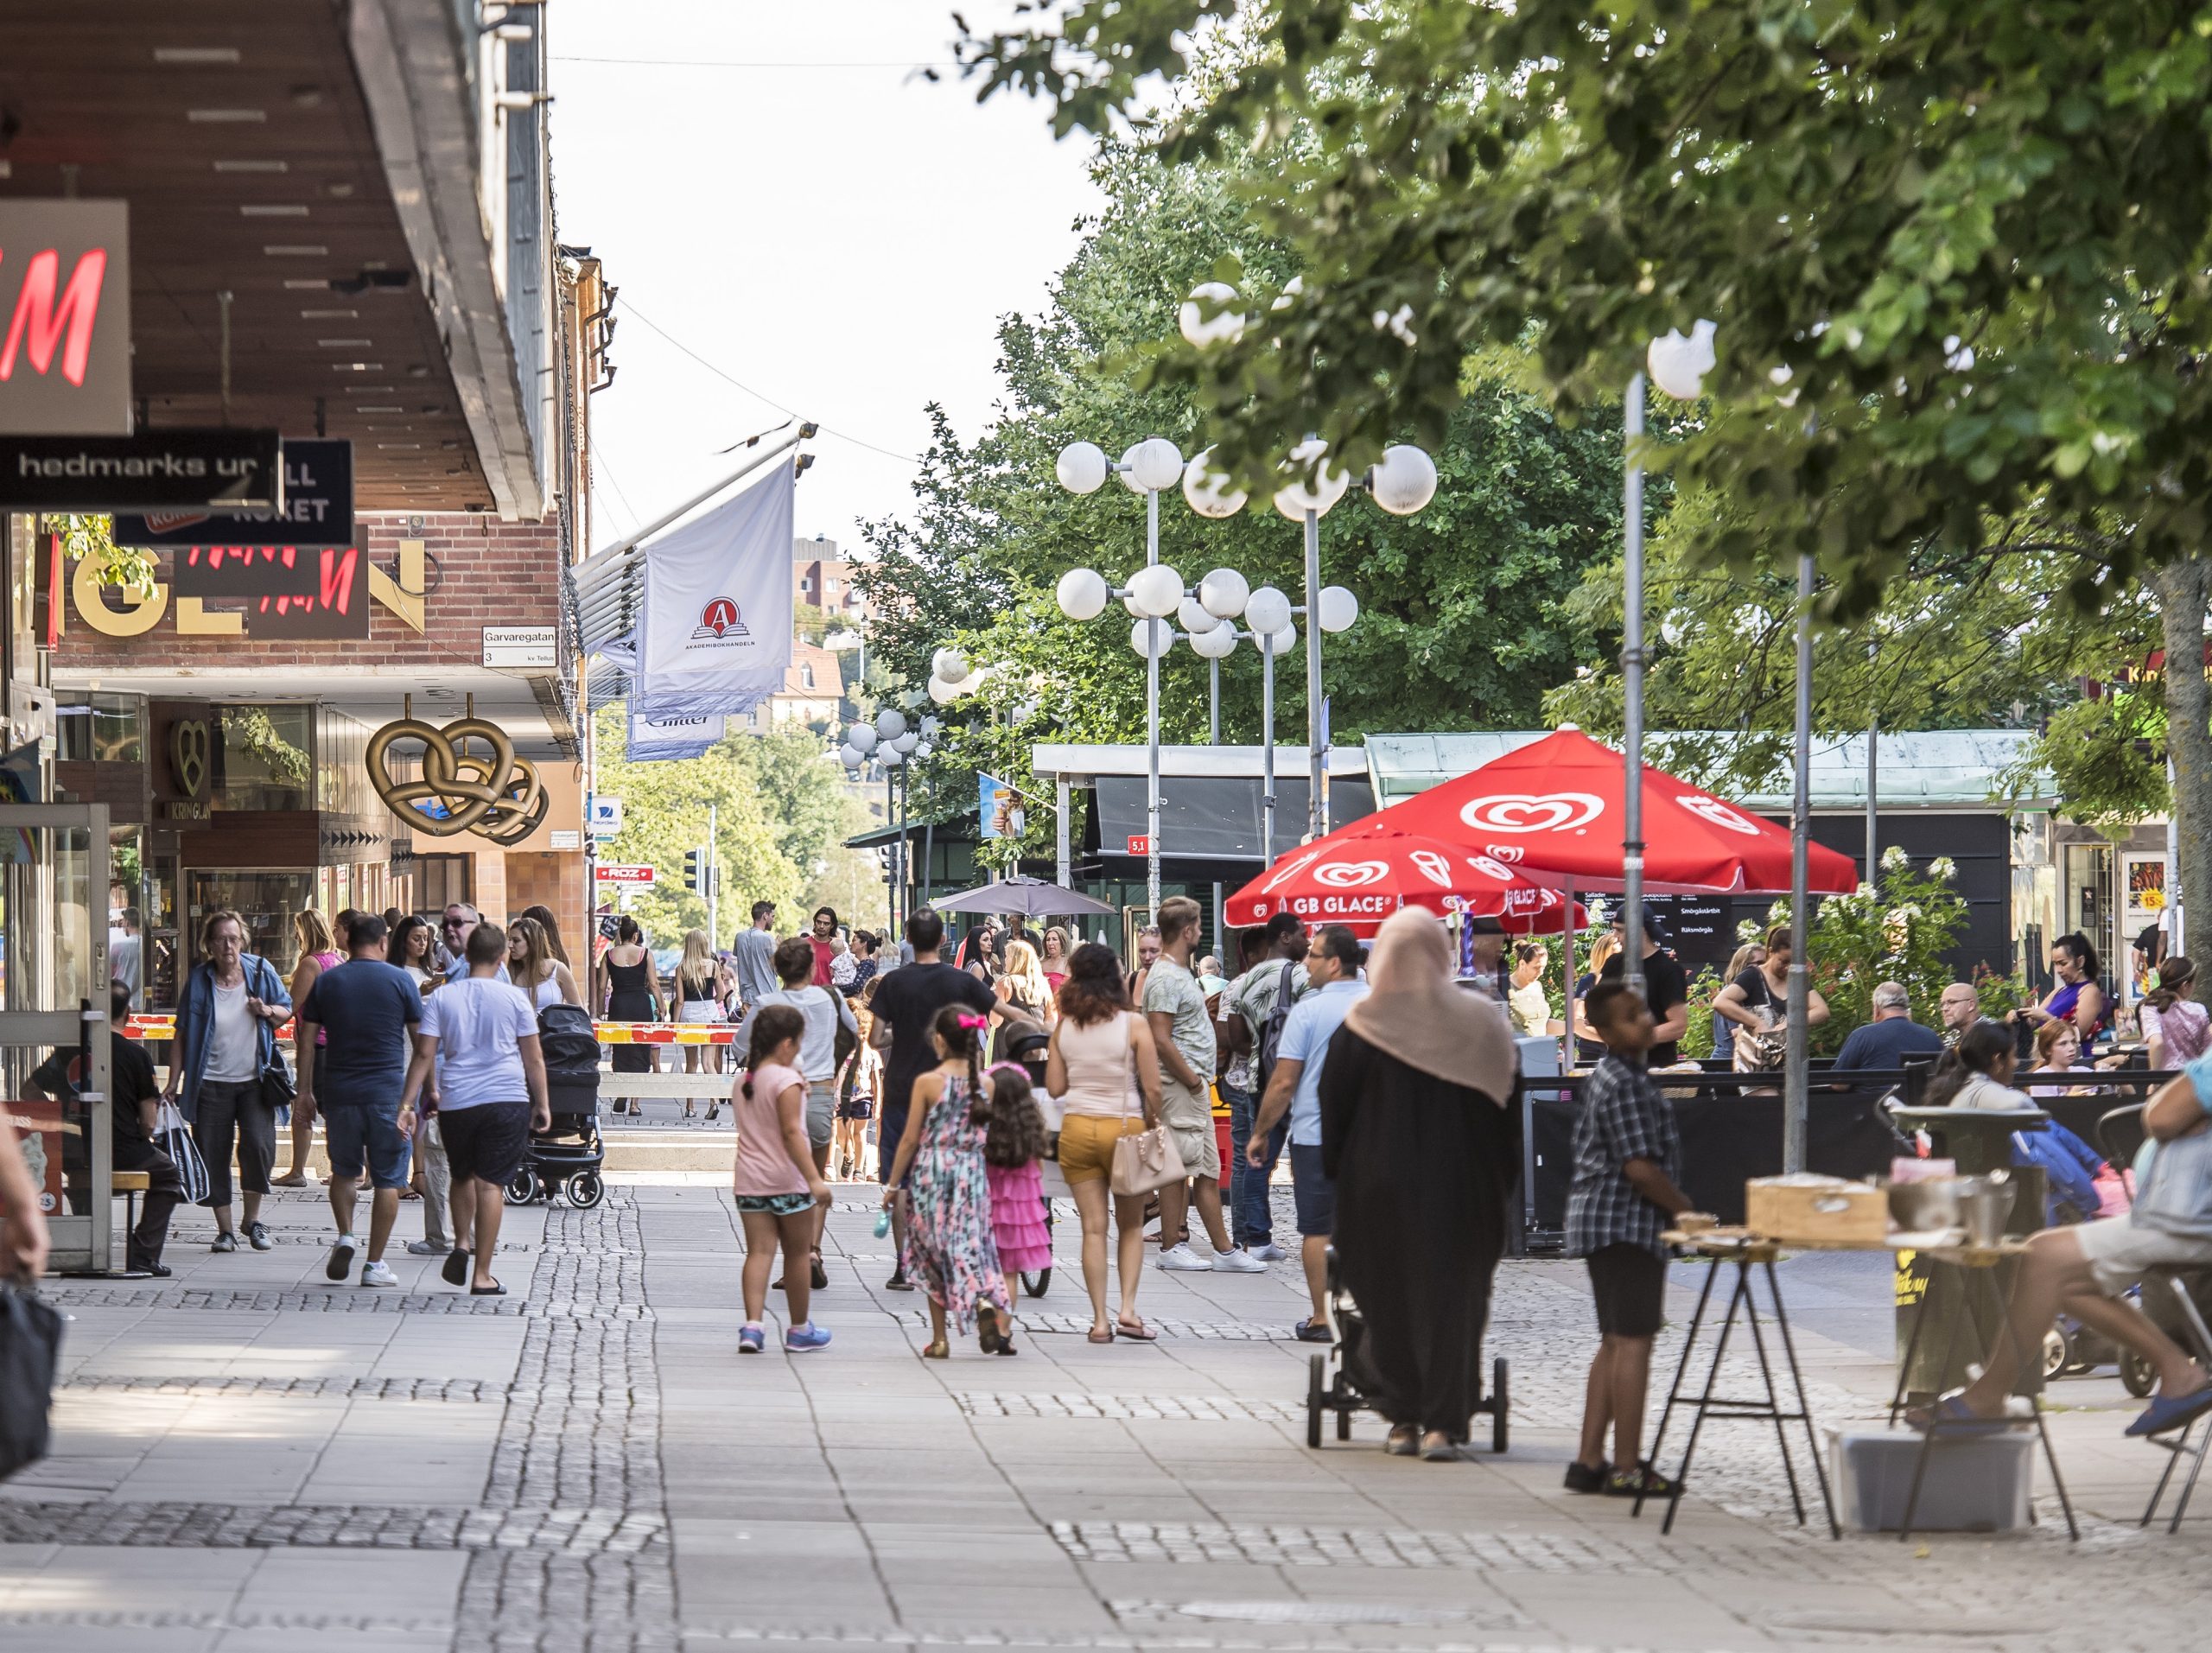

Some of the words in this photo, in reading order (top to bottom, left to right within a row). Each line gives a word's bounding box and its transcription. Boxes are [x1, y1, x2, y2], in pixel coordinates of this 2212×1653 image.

[19, 452, 206, 477] hedmarks
[485, 633, 554, 643] Garvaregatan
[685, 641, 755, 650] AKADEMIBOKHANDELN
[485, 652, 493, 662] 3
[608, 868, 639, 878] ROZ
[1294, 897, 1319, 914] GB
